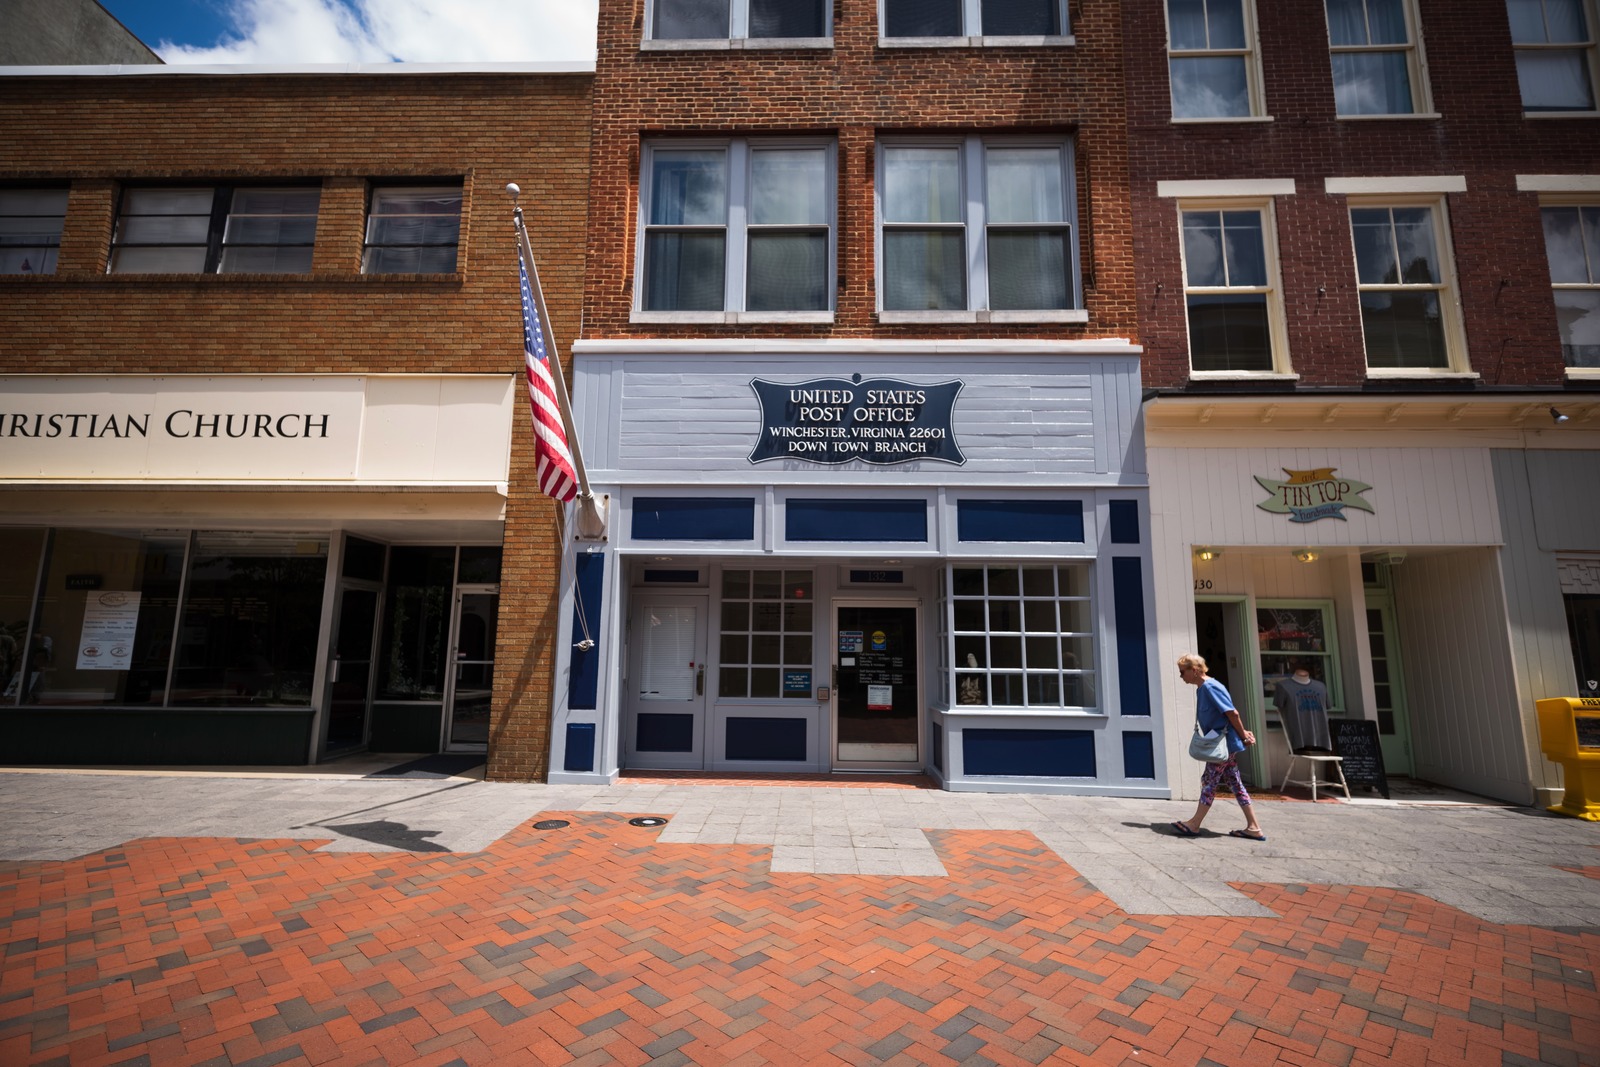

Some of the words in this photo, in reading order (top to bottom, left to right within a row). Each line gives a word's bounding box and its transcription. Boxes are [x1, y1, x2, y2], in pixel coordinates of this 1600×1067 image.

[789, 389, 854, 405] UNITED
[866, 389, 926, 405] STATES
[799, 406, 844, 422] POST
[853, 406, 916, 422] OFFICE
[0, 412, 151, 438] RISTIAN
[164, 409, 329, 438] CHURCH
[851, 426, 905, 439] VIRGINIA
[909, 427, 946, 439] 22601
[788, 441, 828, 453] DOWN
[832, 441, 869, 453] TOWN
[874, 441, 927, 453] BRANCH
[1301, 471, 1317, 482] art
[1278, 485, 1313, 506] TIN
[1312, 481, 1350, 503] TOP
[1299, 505, 1337, 520] handmade
[868, 571, 886, 581] 132
[1194, 579, 1213, 590] 130
[1340, 724, 1358, 735] ART
